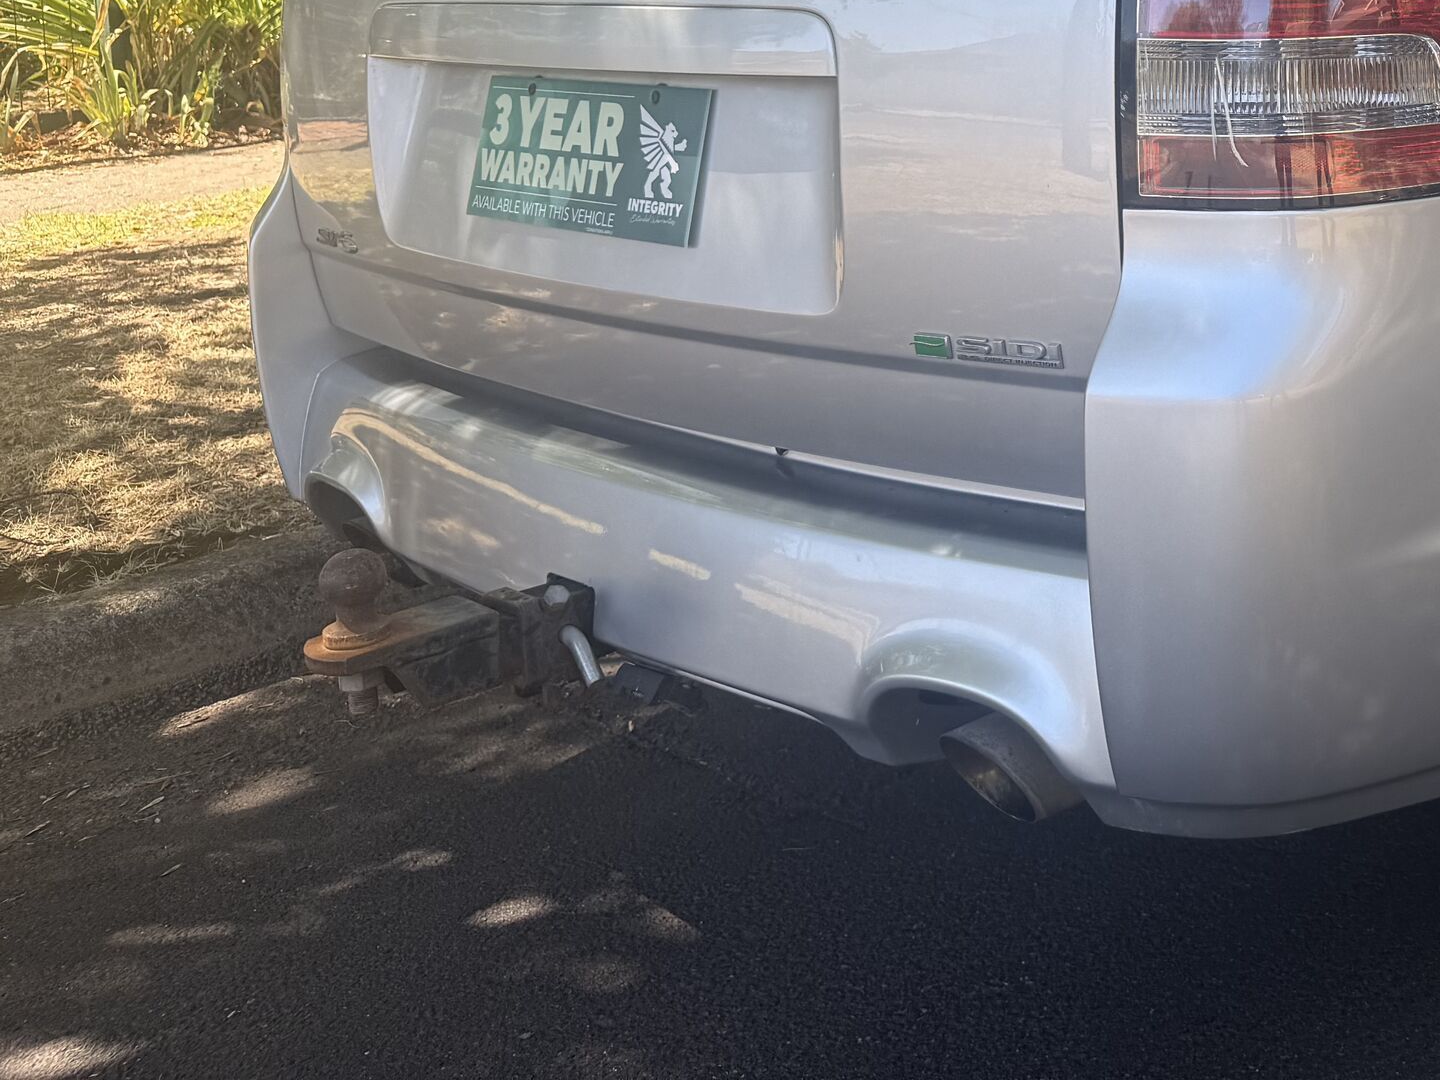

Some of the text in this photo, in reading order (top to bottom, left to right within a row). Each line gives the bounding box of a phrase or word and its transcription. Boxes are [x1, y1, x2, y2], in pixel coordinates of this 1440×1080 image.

[490, 93, 625, 157] 3 YEAR
[481, 148, 624, 197] WARRANTY
[472, 195, 521, 214] AVAILABLE
[522, 201, 547, 219] WITH
[549, 205, 570, 221] THIS
[572, 208, 616, 228] VEHICLE
[627, 198, 683, 217] INTEGRITY
[955, 336, 1064, 368] SIDI
